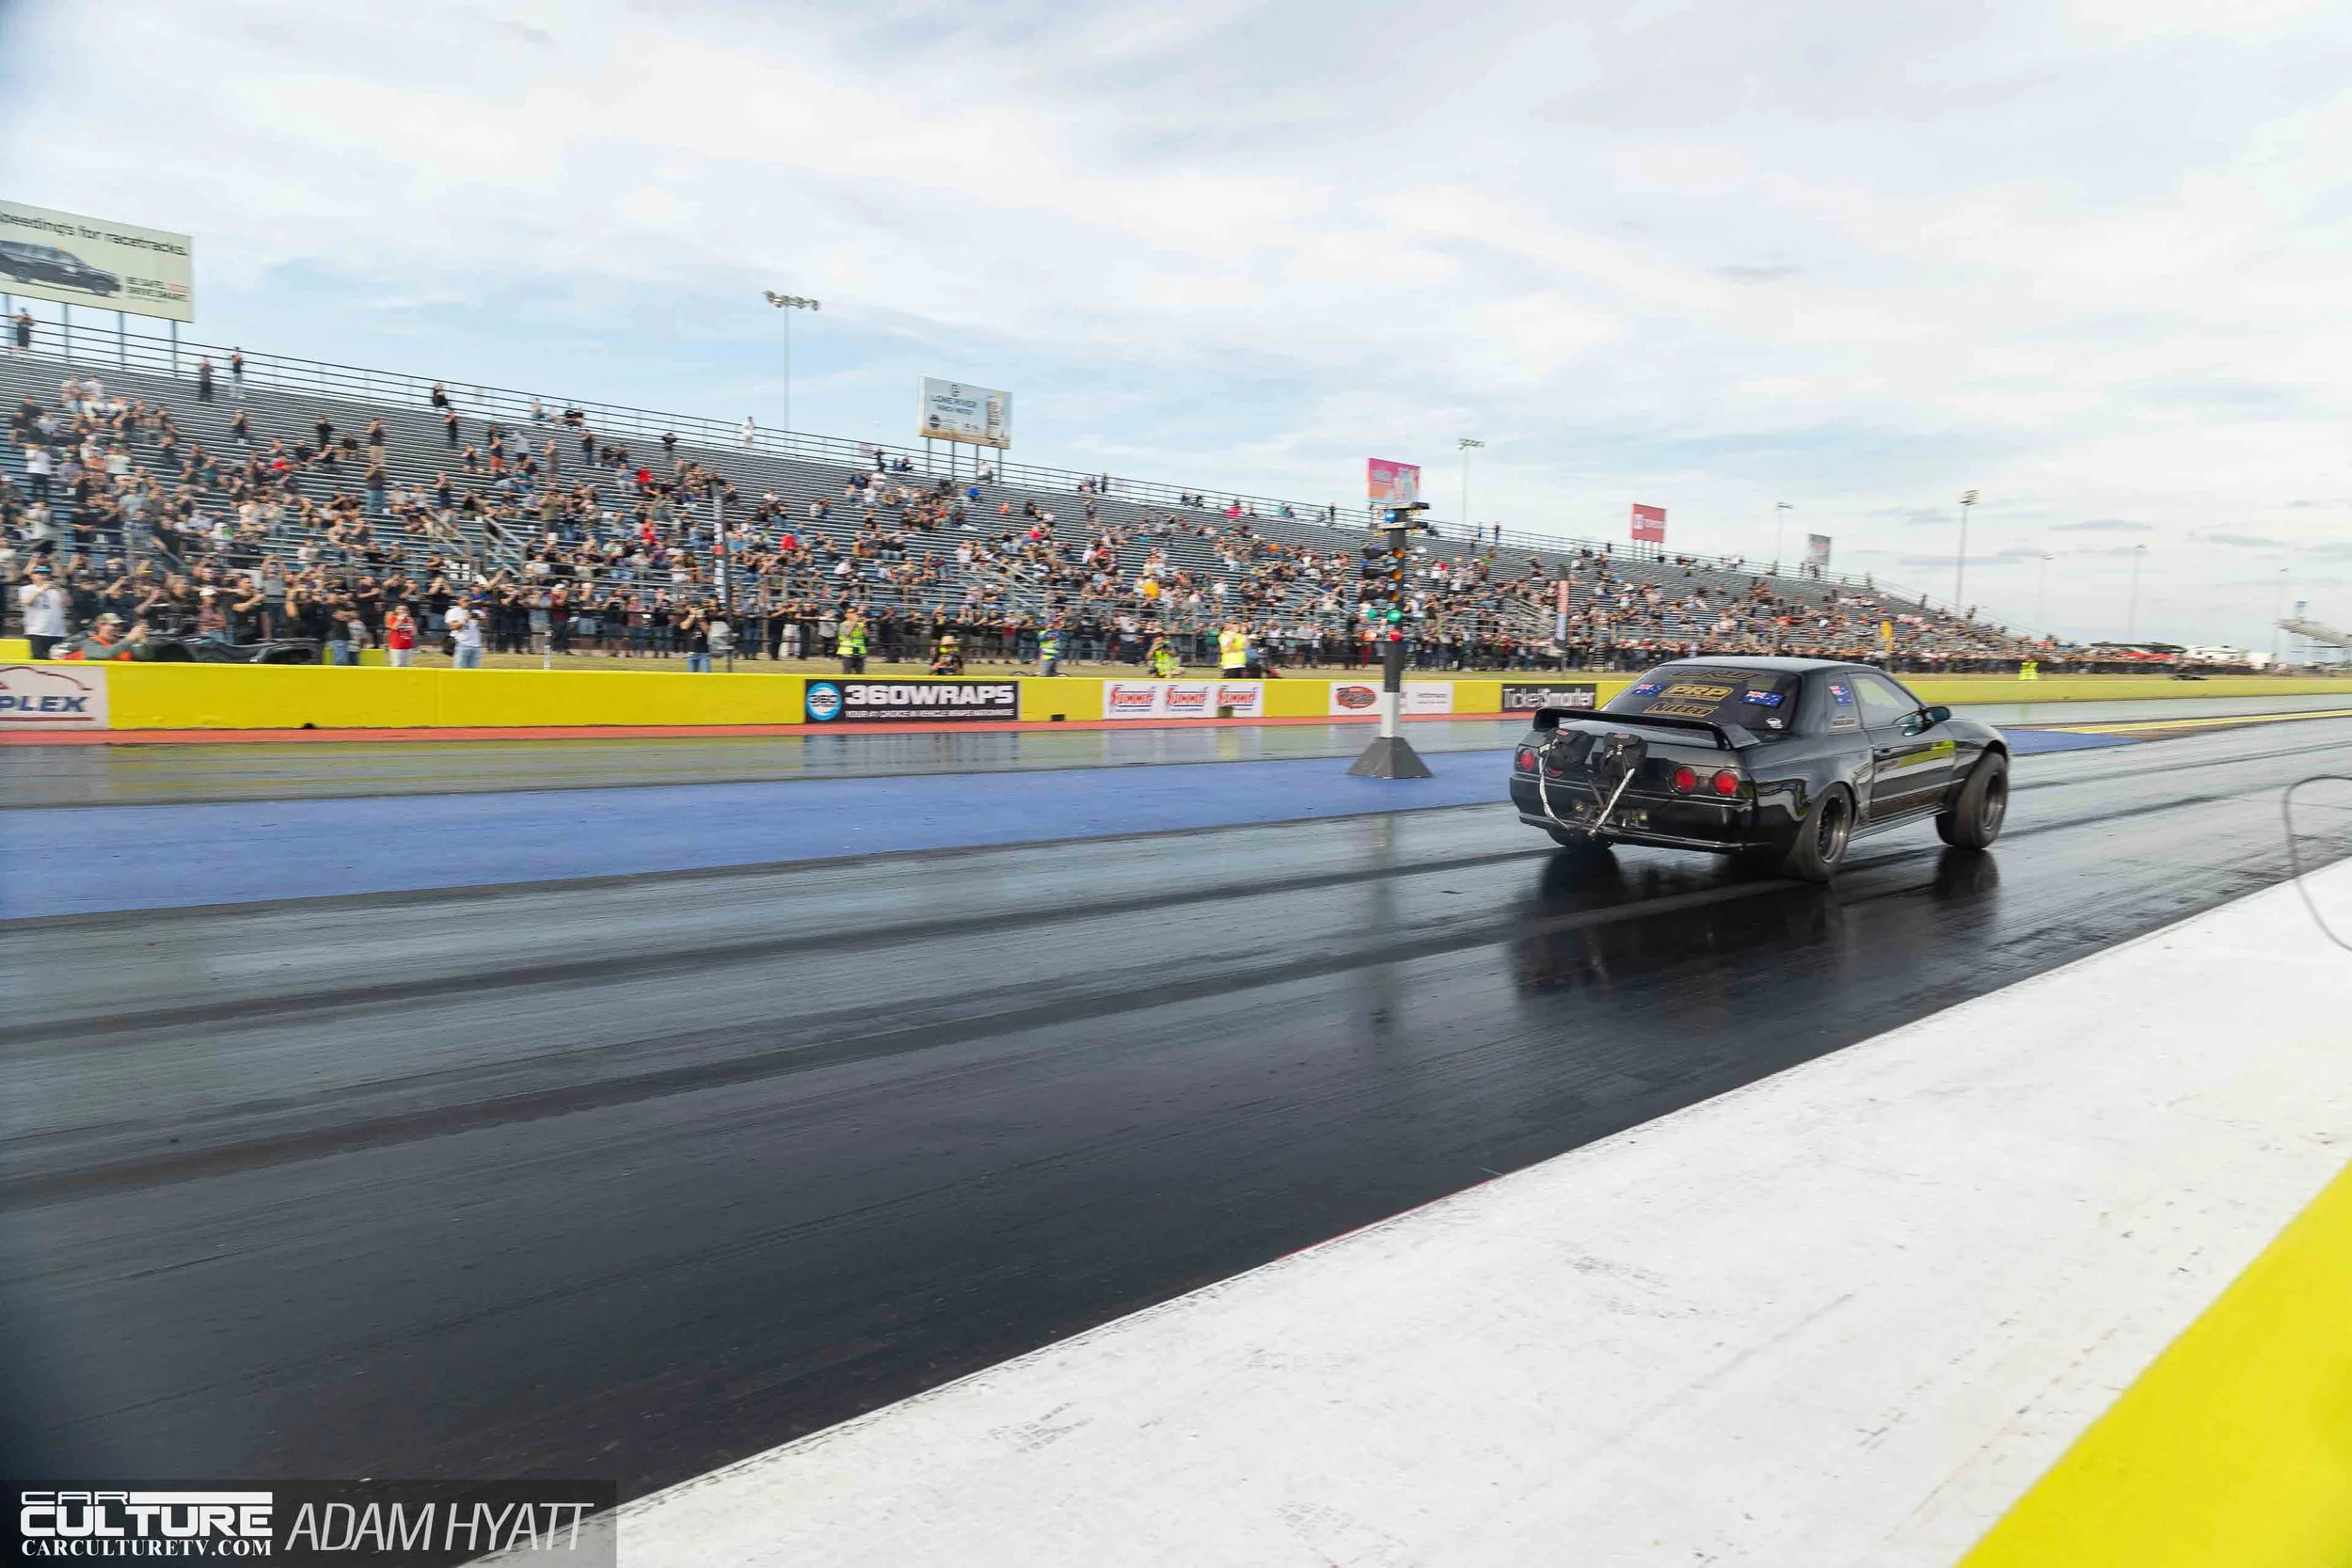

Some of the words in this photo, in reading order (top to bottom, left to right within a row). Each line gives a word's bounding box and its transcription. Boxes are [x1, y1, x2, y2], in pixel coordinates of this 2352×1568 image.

[79, 224, 101, 239] for
[845, 685, 1015, 705] 360WRAPS
[1667, 685, 1728, 697] PRP
